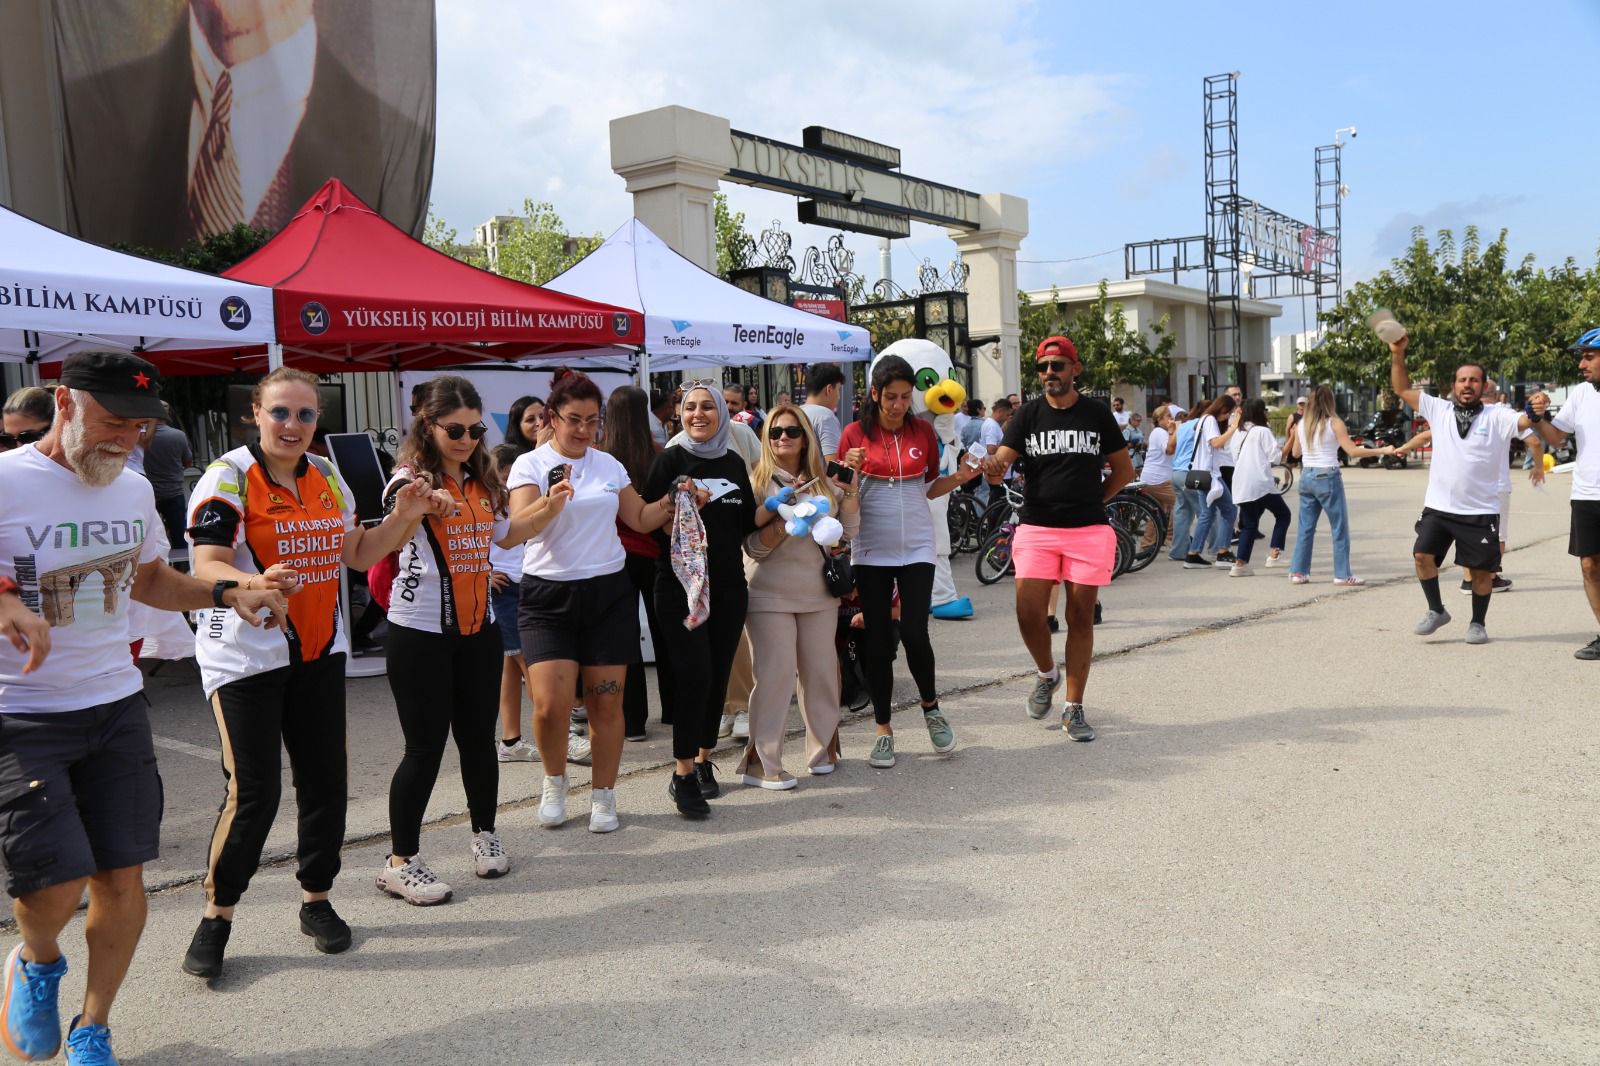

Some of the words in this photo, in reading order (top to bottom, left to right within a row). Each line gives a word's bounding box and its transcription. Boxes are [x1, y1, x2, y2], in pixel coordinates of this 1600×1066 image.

[0, 283, 77, 311] BİLİM
[84, 293, 203, 319] KAMPÜSÜ
[342, 307, 427, 330] YÜKSELİŞ
[431, 309, 487, 330] KOLEJİ
[490, 309, 535, 328] BİLİM
[538, 312, 604, 329] KAMPÜSÜ
[663, 335, 702, 348] TeenEagle
[732, 323, 805, 349] TeenEagle
[830, 343, 859, 353] TeenEagle
[275, 519, 298, 534] İLK
[446, 523, 462, 535] İLK
[277, 533, 345, 556] BİSİKLET
[311, 551, 342, 566] KULÜB
